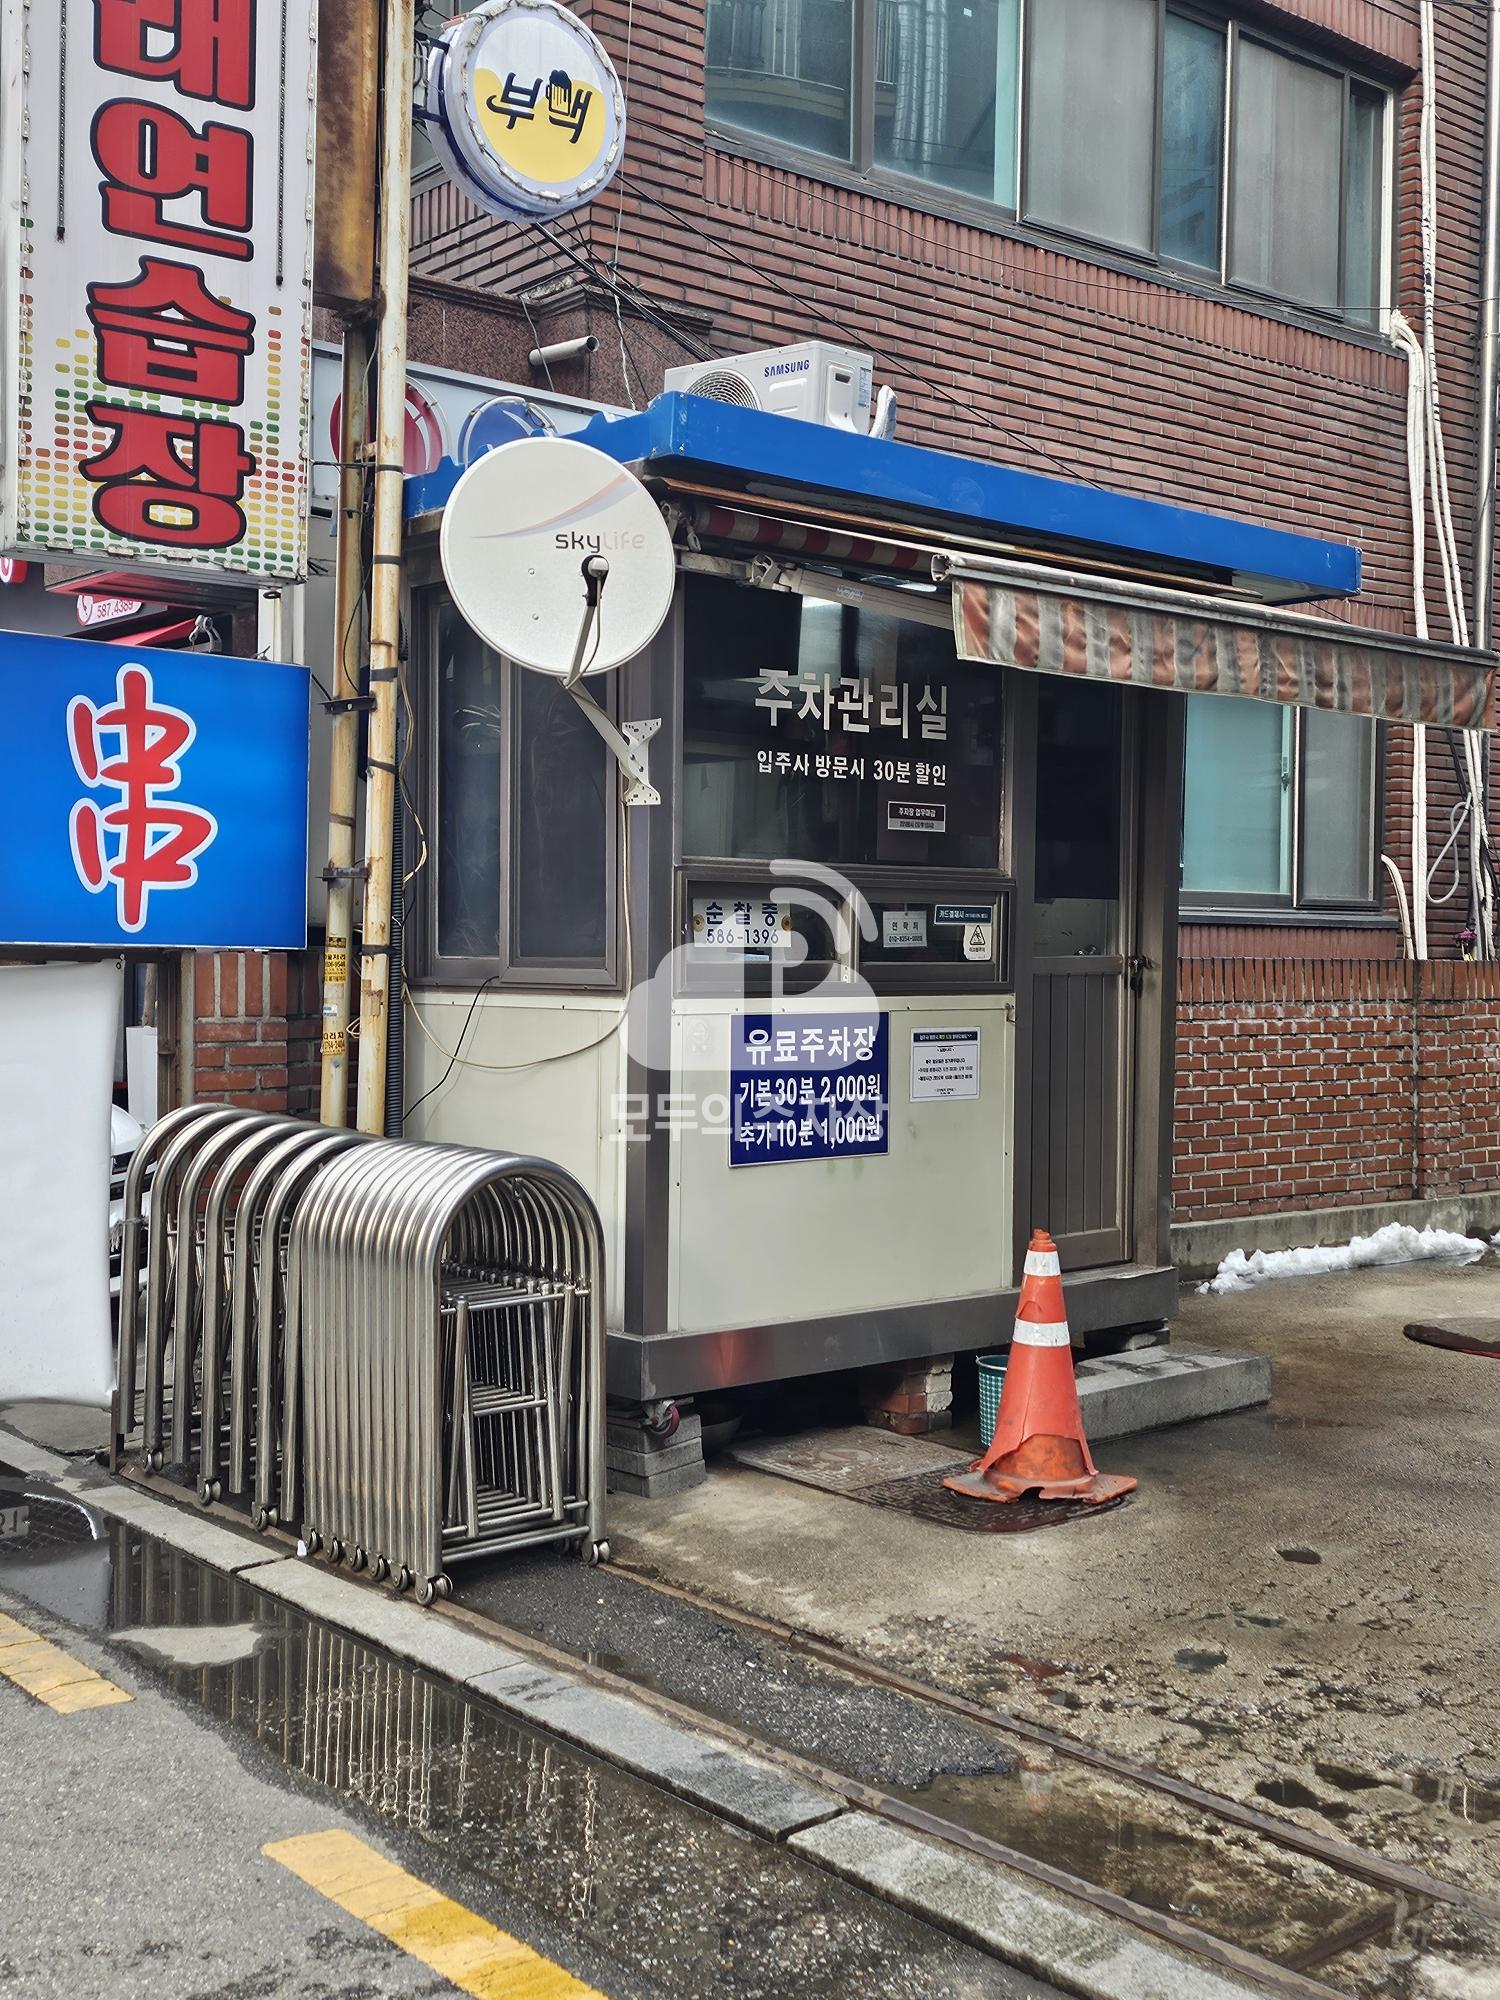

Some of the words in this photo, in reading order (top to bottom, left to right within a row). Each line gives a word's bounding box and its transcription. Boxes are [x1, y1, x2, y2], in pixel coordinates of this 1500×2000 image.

[764, 359, 810, 378] SAMSUNG
[755, 668, 947, 741] 주차관리실
[757, 750, 810, 776] 입주사
[815, 754, 865, 780] 방문시
[873, 760, 911, 784] 30분
[915, 762, 946, 787] 할인
[66, 662, 218, 933] 串
[706, 928, 779, 944] 586-1396
[746, 1025, 876, 1066] 유료주차장
[820, 1074, 881, 1108] 2,000원
[821, 1113, 880, 1149] 1,000원
